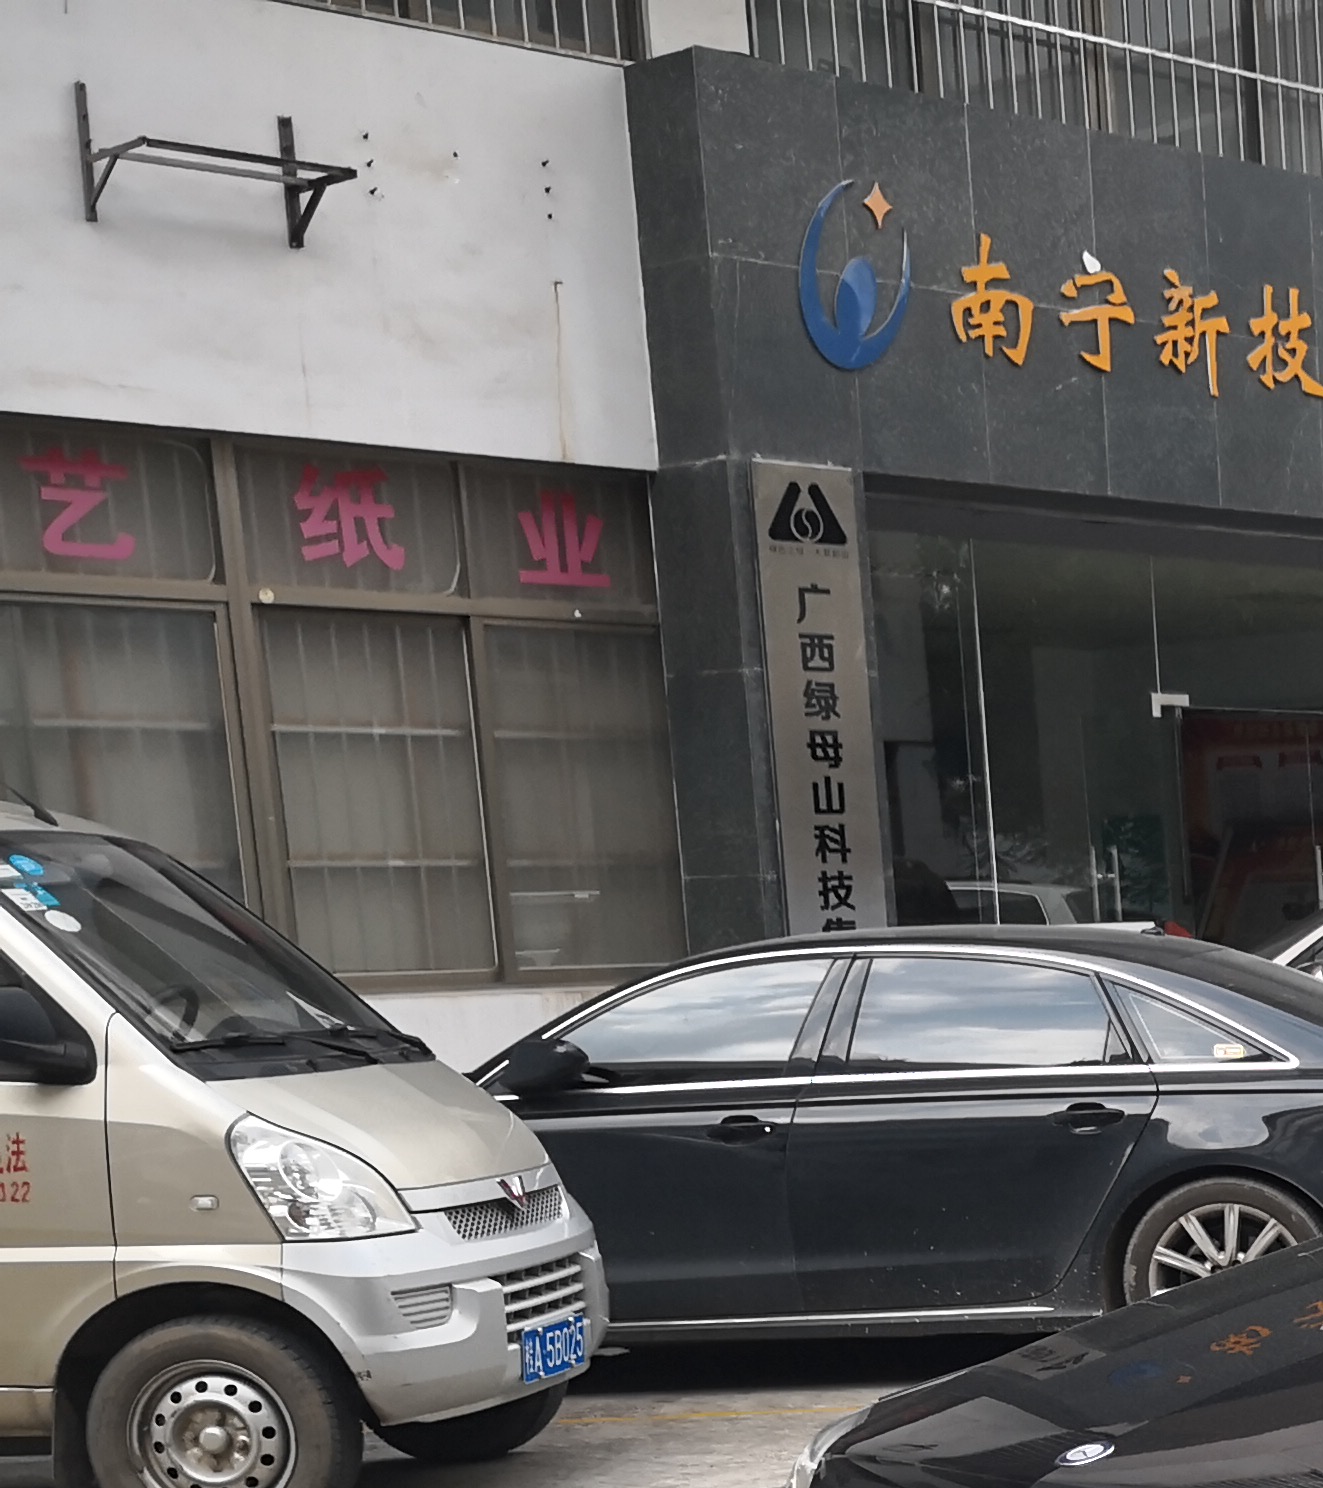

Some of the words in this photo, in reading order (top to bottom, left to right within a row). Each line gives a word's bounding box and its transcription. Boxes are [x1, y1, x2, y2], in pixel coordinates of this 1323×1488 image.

[20, 447, 612, 588] 艺纸业
[0, 1131, 28, 1173] 法
